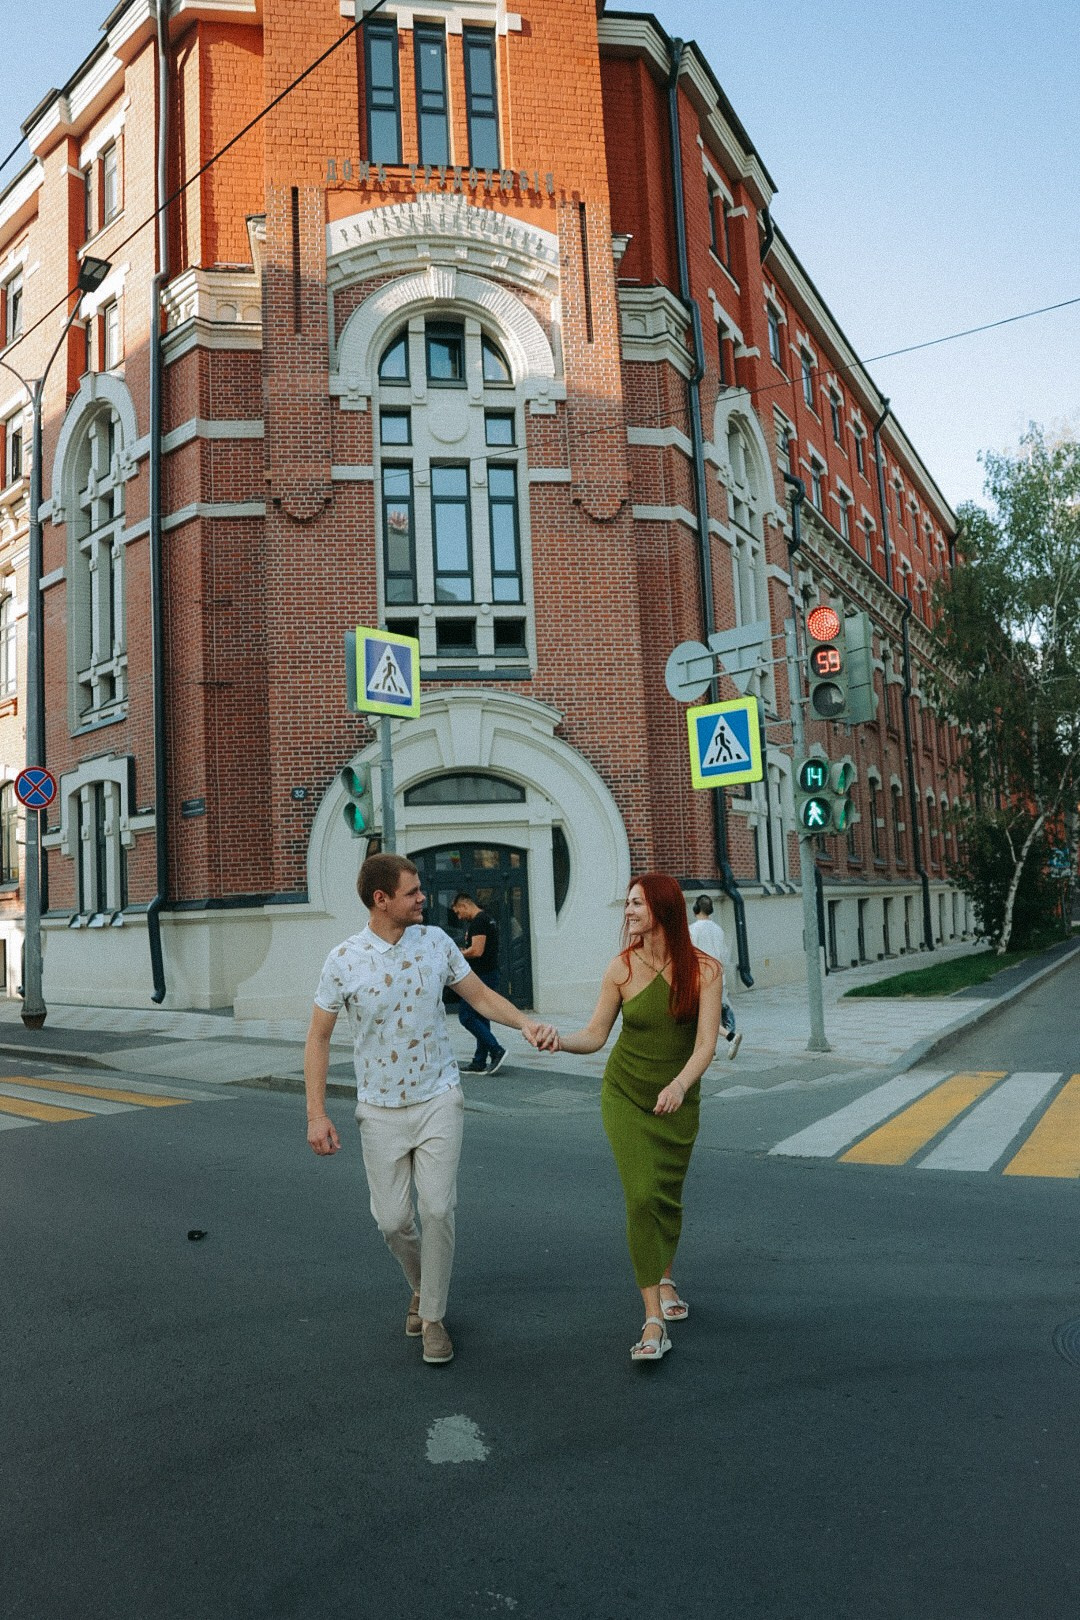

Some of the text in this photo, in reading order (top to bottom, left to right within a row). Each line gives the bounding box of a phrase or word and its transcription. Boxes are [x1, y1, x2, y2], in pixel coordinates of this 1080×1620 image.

[326, 158, 387, 184] ДОМЪ
[817, 650, 840, 673] 59
[807, 767, 822, 786] 14
[294, 790, 304, 798] 32
